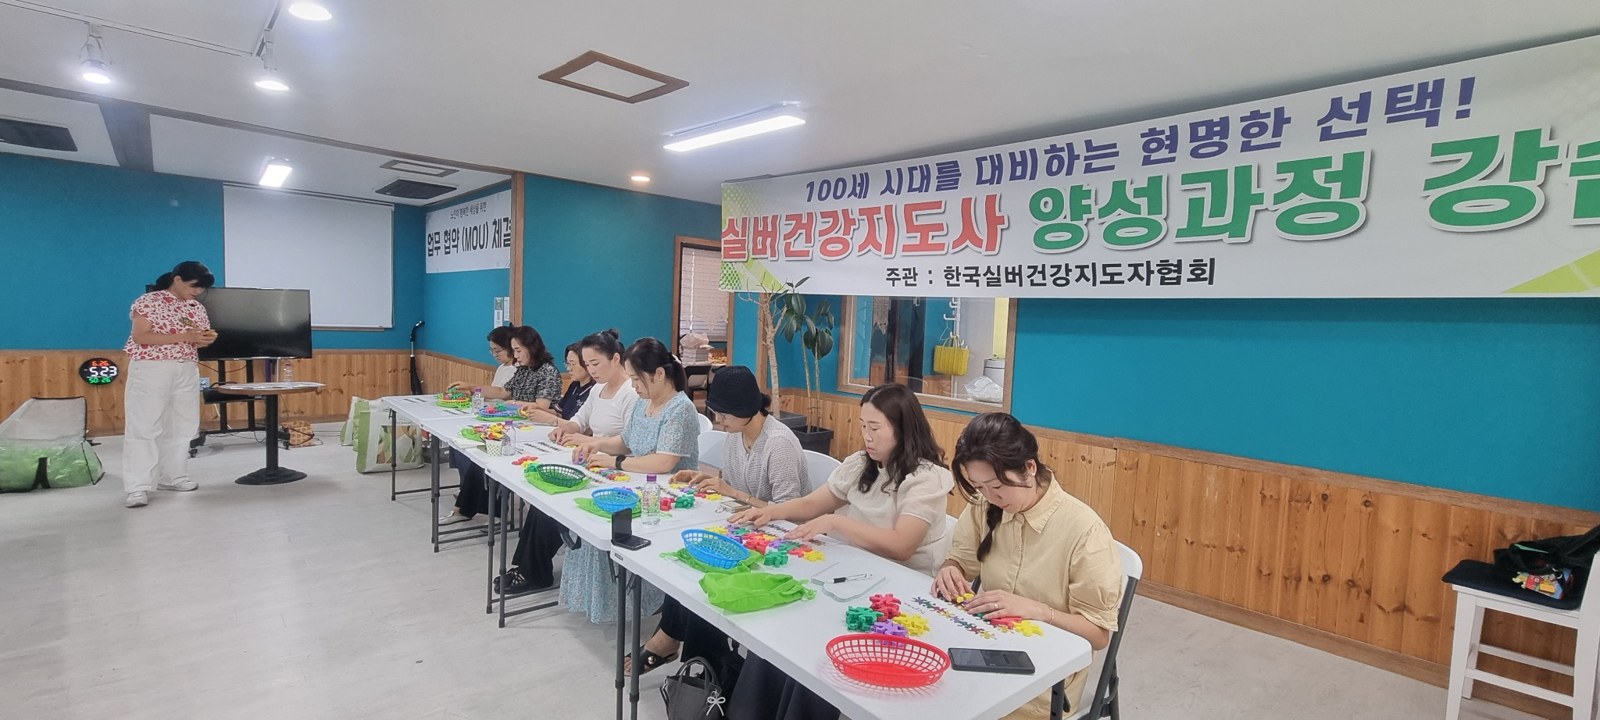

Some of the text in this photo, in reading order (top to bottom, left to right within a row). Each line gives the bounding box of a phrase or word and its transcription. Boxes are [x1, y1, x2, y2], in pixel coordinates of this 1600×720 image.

[806, 76, 1476, 203] 100세 시대를 대비하는 현명한 선택!
[427, 216, 511, 257] 업무 협약 (MOU) 체결
[721, 193, 1007, 260] 실버건강지도사
[1028, 150, 1371, 253] 양성과정
[885, 266, 919, 287] 주관
[943, 257, 1216, 288] 한국실버건강지도자협회
